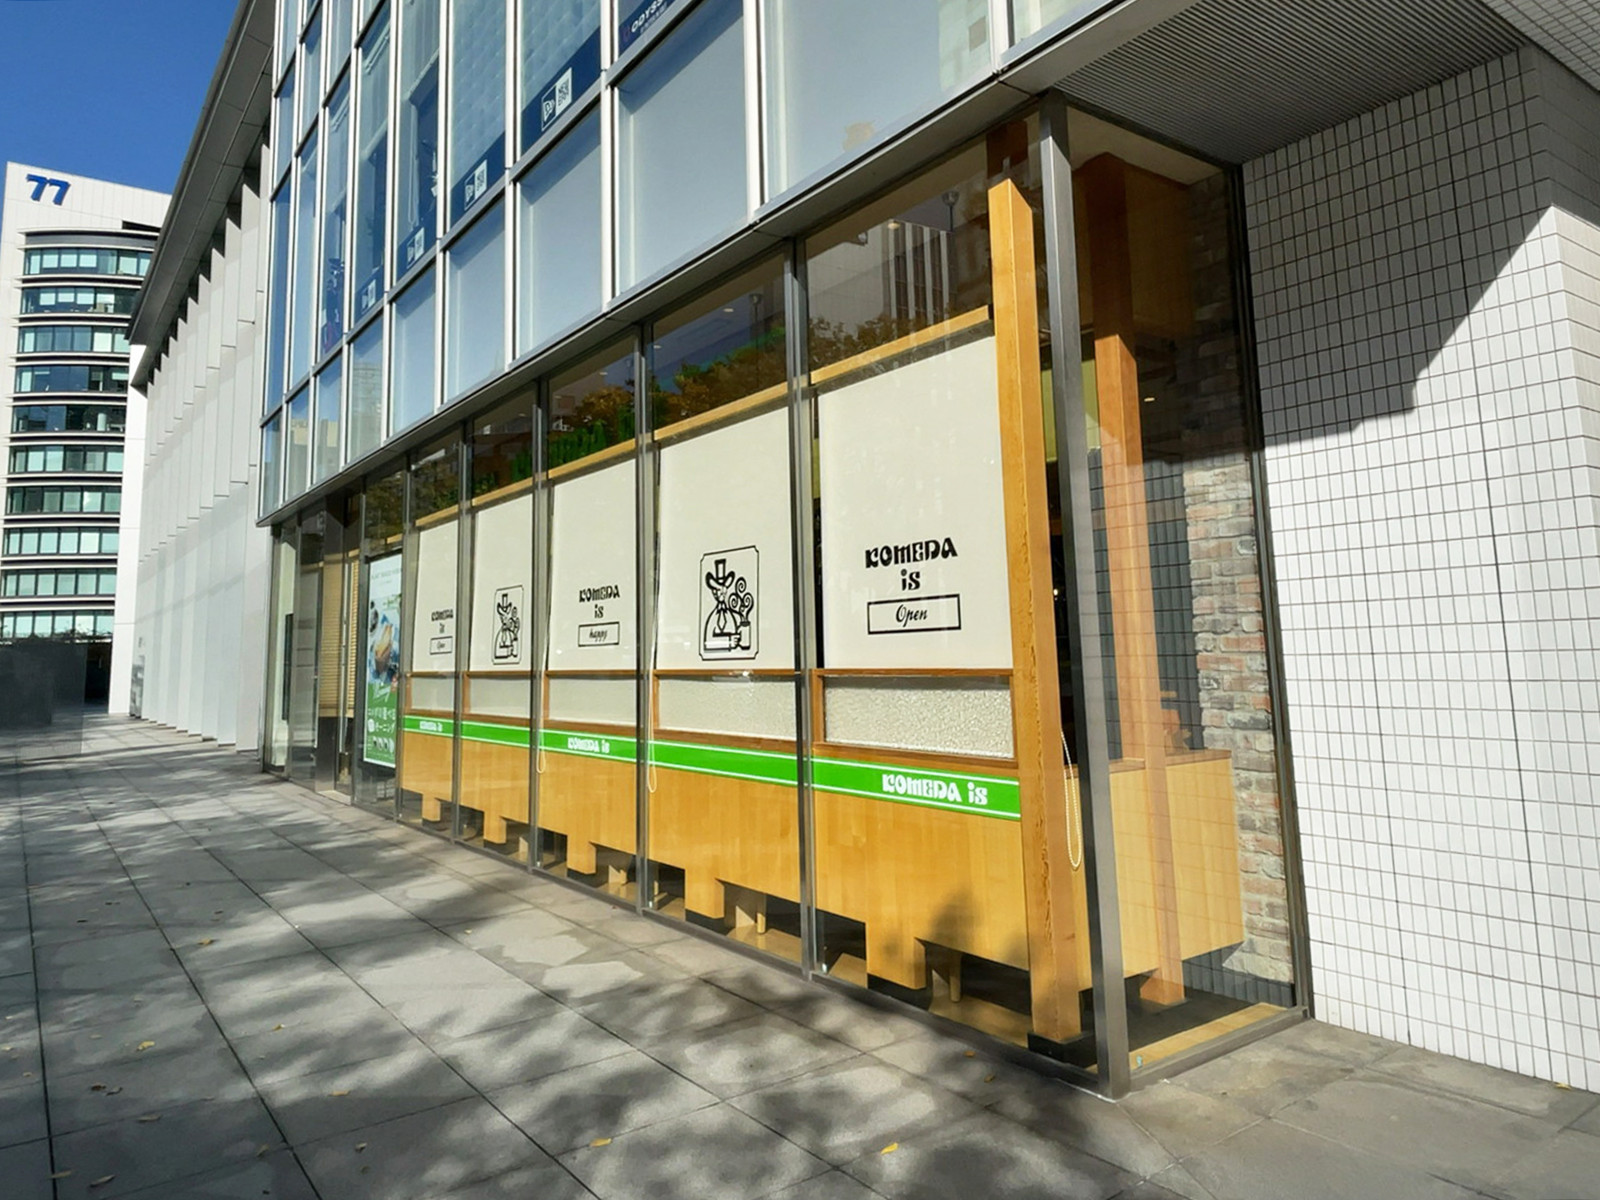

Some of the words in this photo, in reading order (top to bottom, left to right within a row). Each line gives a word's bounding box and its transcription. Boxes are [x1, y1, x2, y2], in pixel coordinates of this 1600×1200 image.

[25, 174, 71, 207] 77
[865, 537, 958, 568] KOMEDA
[900, 568, 920, 591] is
[579, 584, 620, 603] KOMEDA
[594, 603, 604, 619] is
[895, 604, 928, 628] Open
[567, 736, 600, 753] KOMEDA
[882, 774, 962, 802] KOMEDA
[967, 781, 988, 805] is
